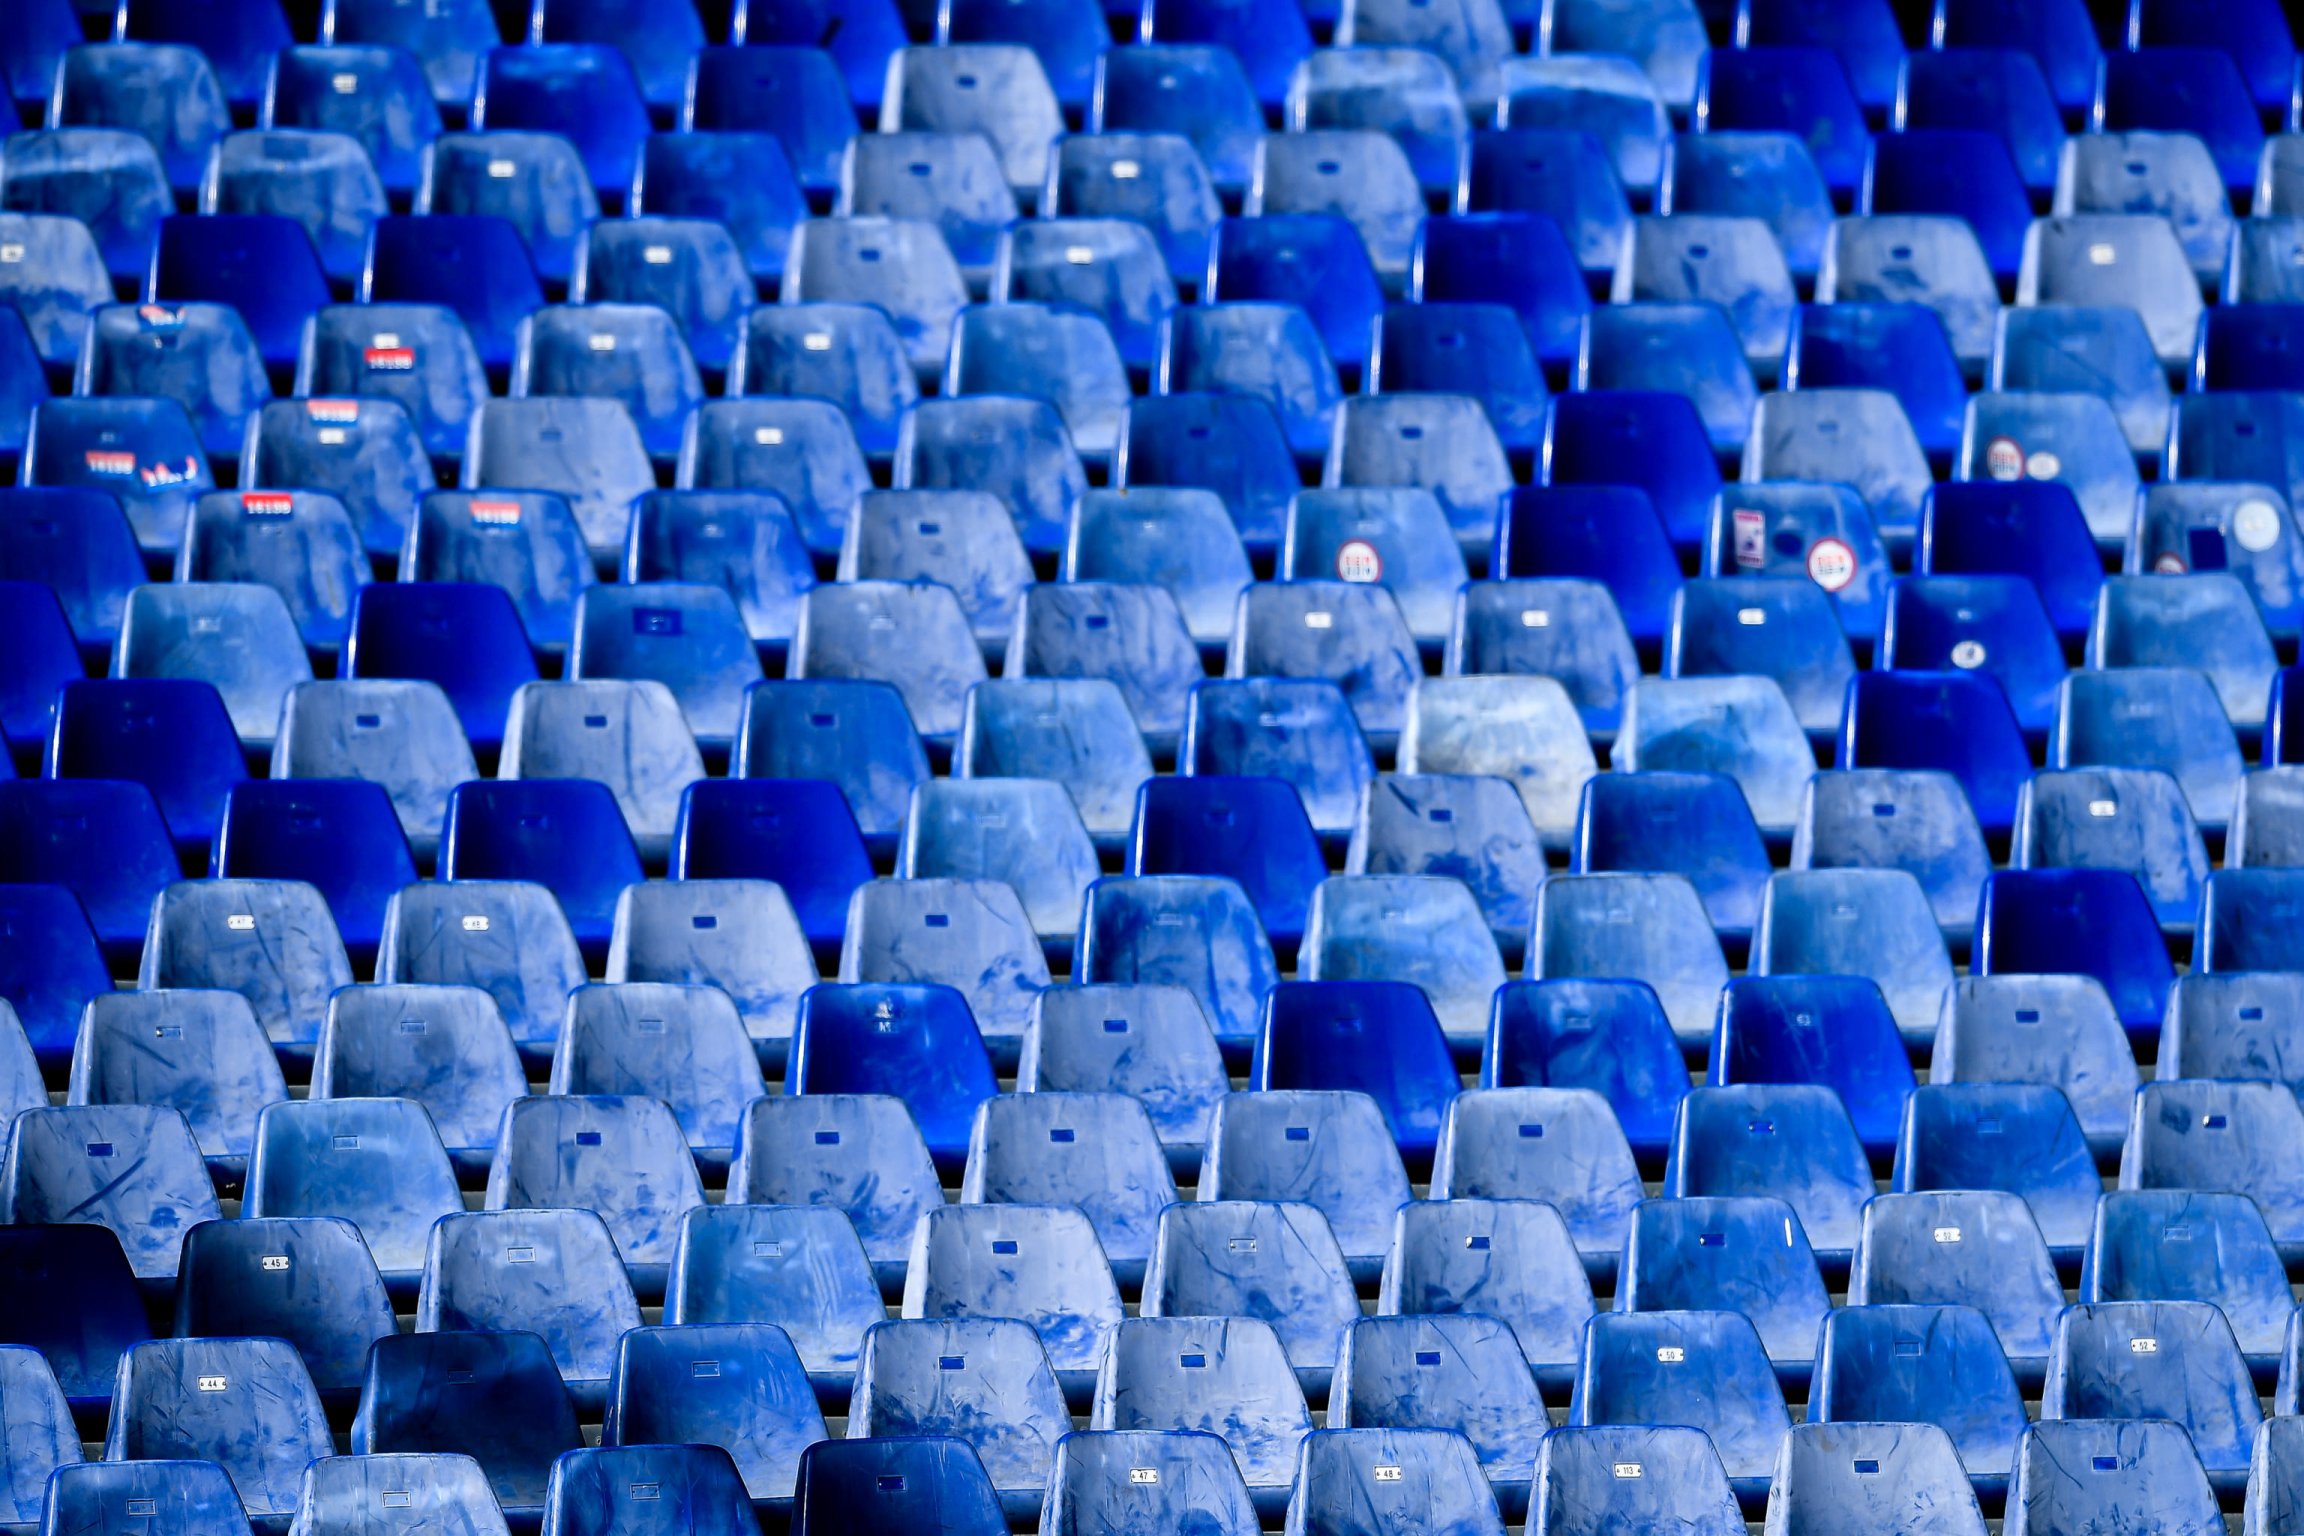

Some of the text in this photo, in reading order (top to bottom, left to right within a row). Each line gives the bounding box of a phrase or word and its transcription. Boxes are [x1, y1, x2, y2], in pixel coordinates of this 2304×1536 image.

[271, 1259, 280, 1267] 45
[2139, 1341, 2148, 1350] 52
[1666, 1351, 1674, 1360] 50
[208, 1380, 217, 1388] 44
[1384, 1470, 1393, 1478] 48
[1623, 1467, 1633, 1475] 113
[1139, 1472, 1148, 1480] 47
